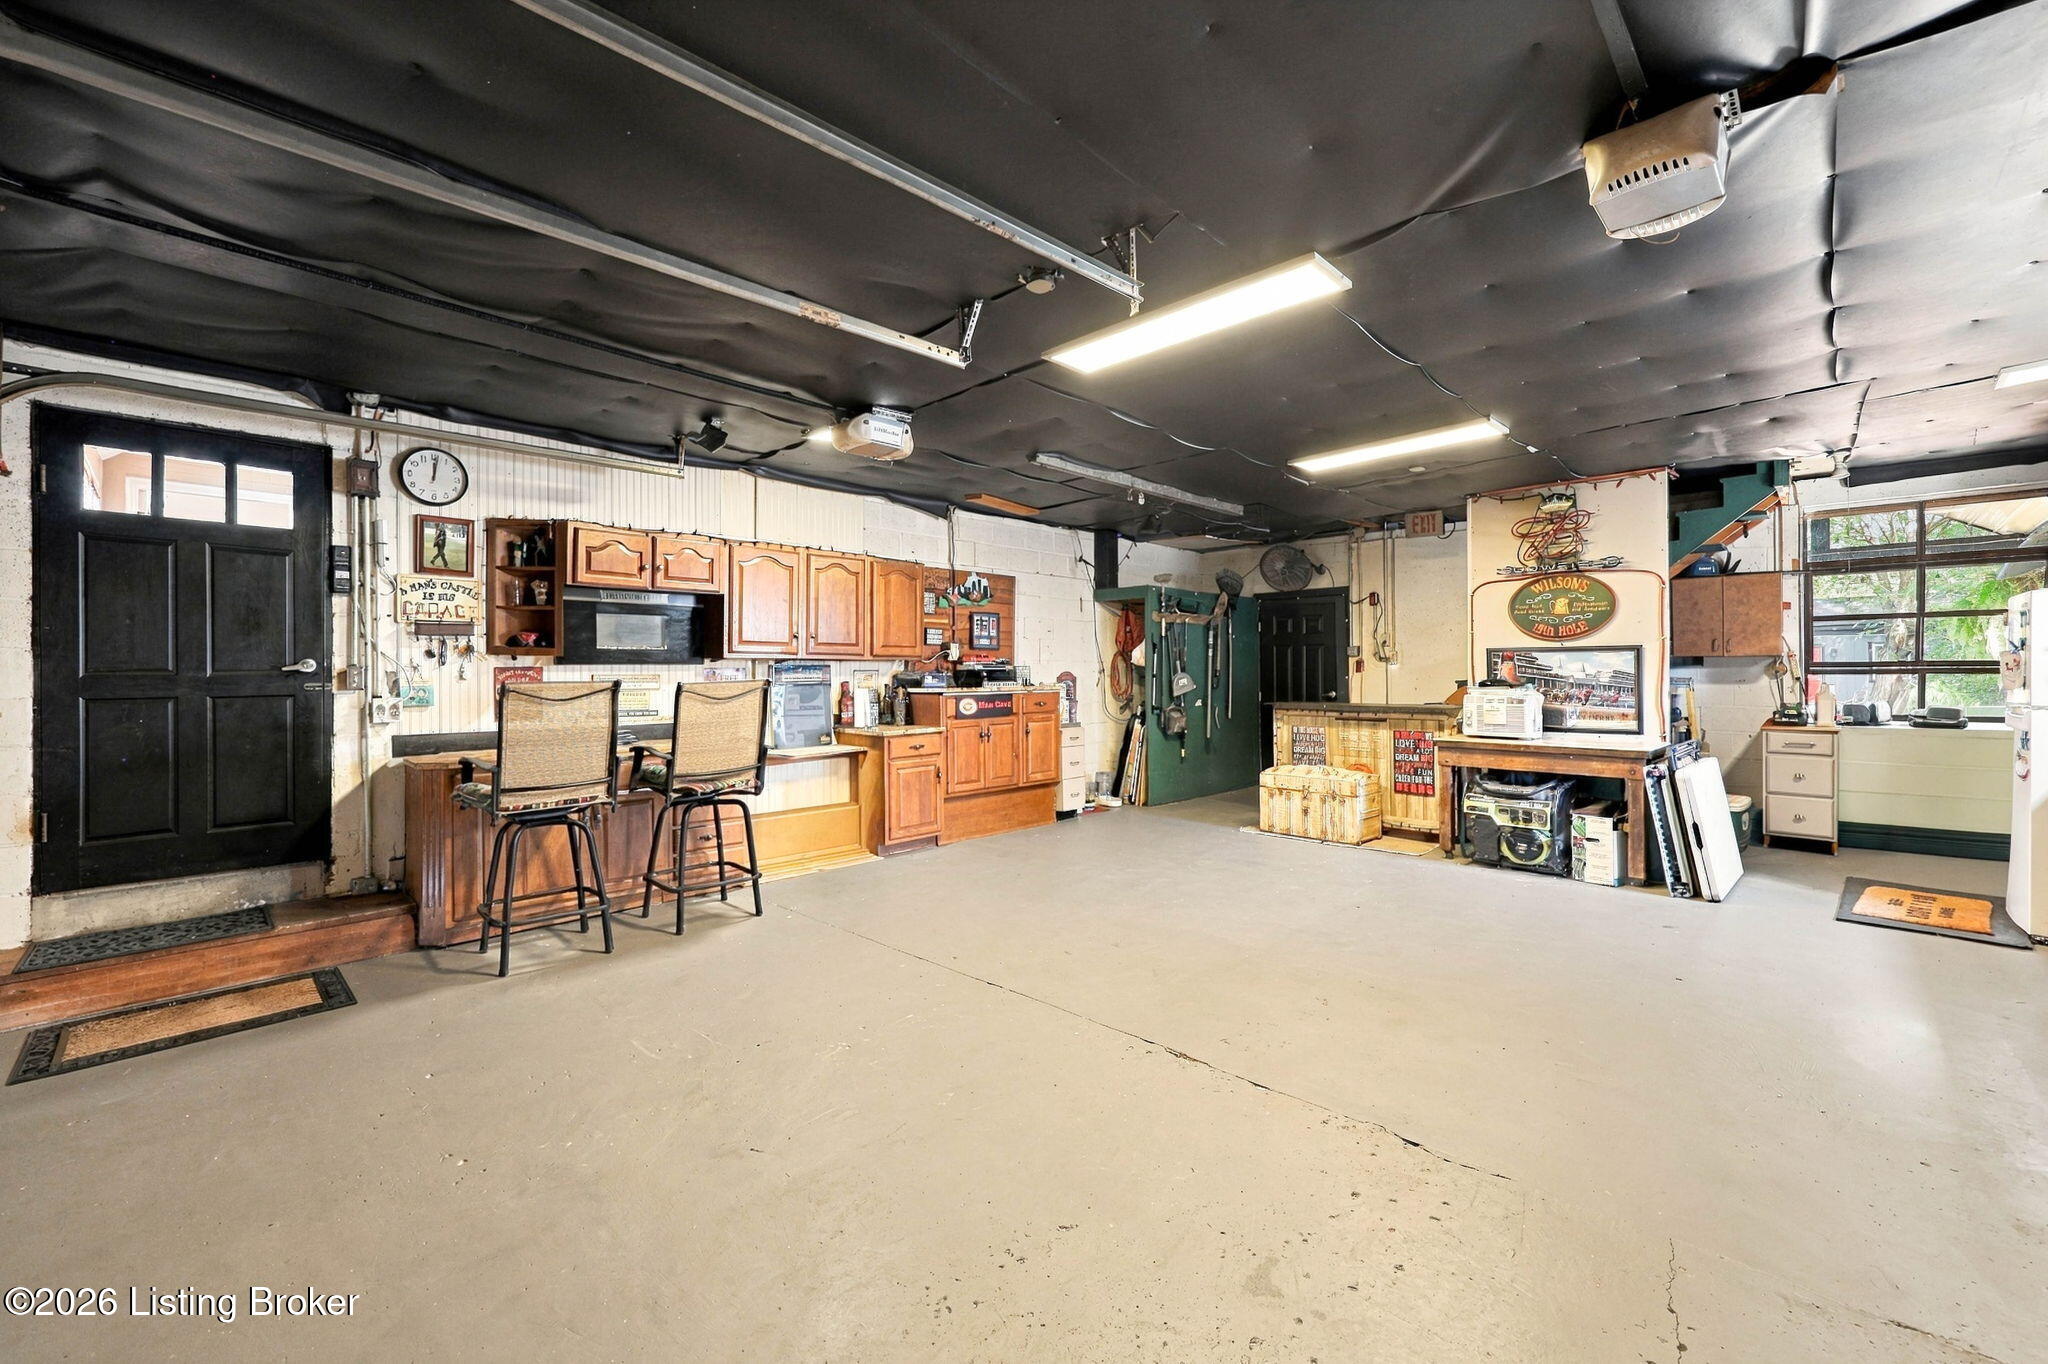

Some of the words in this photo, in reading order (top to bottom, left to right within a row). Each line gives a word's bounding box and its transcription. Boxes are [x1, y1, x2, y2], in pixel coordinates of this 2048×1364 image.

[1412, 513, 1436, 534] EXIT
[409, 578, 437, 592] MAN'S
[440, 582, 480, 600] CASTLE
[422, 592, 435, 600] IS
[1558, 620, 1588, 636] HOLE
[1395, 739, 1415, 748] LOVE
[1395, 753, 1419, 761] DREAM
[1417, 768, 1433, 776] FUN
